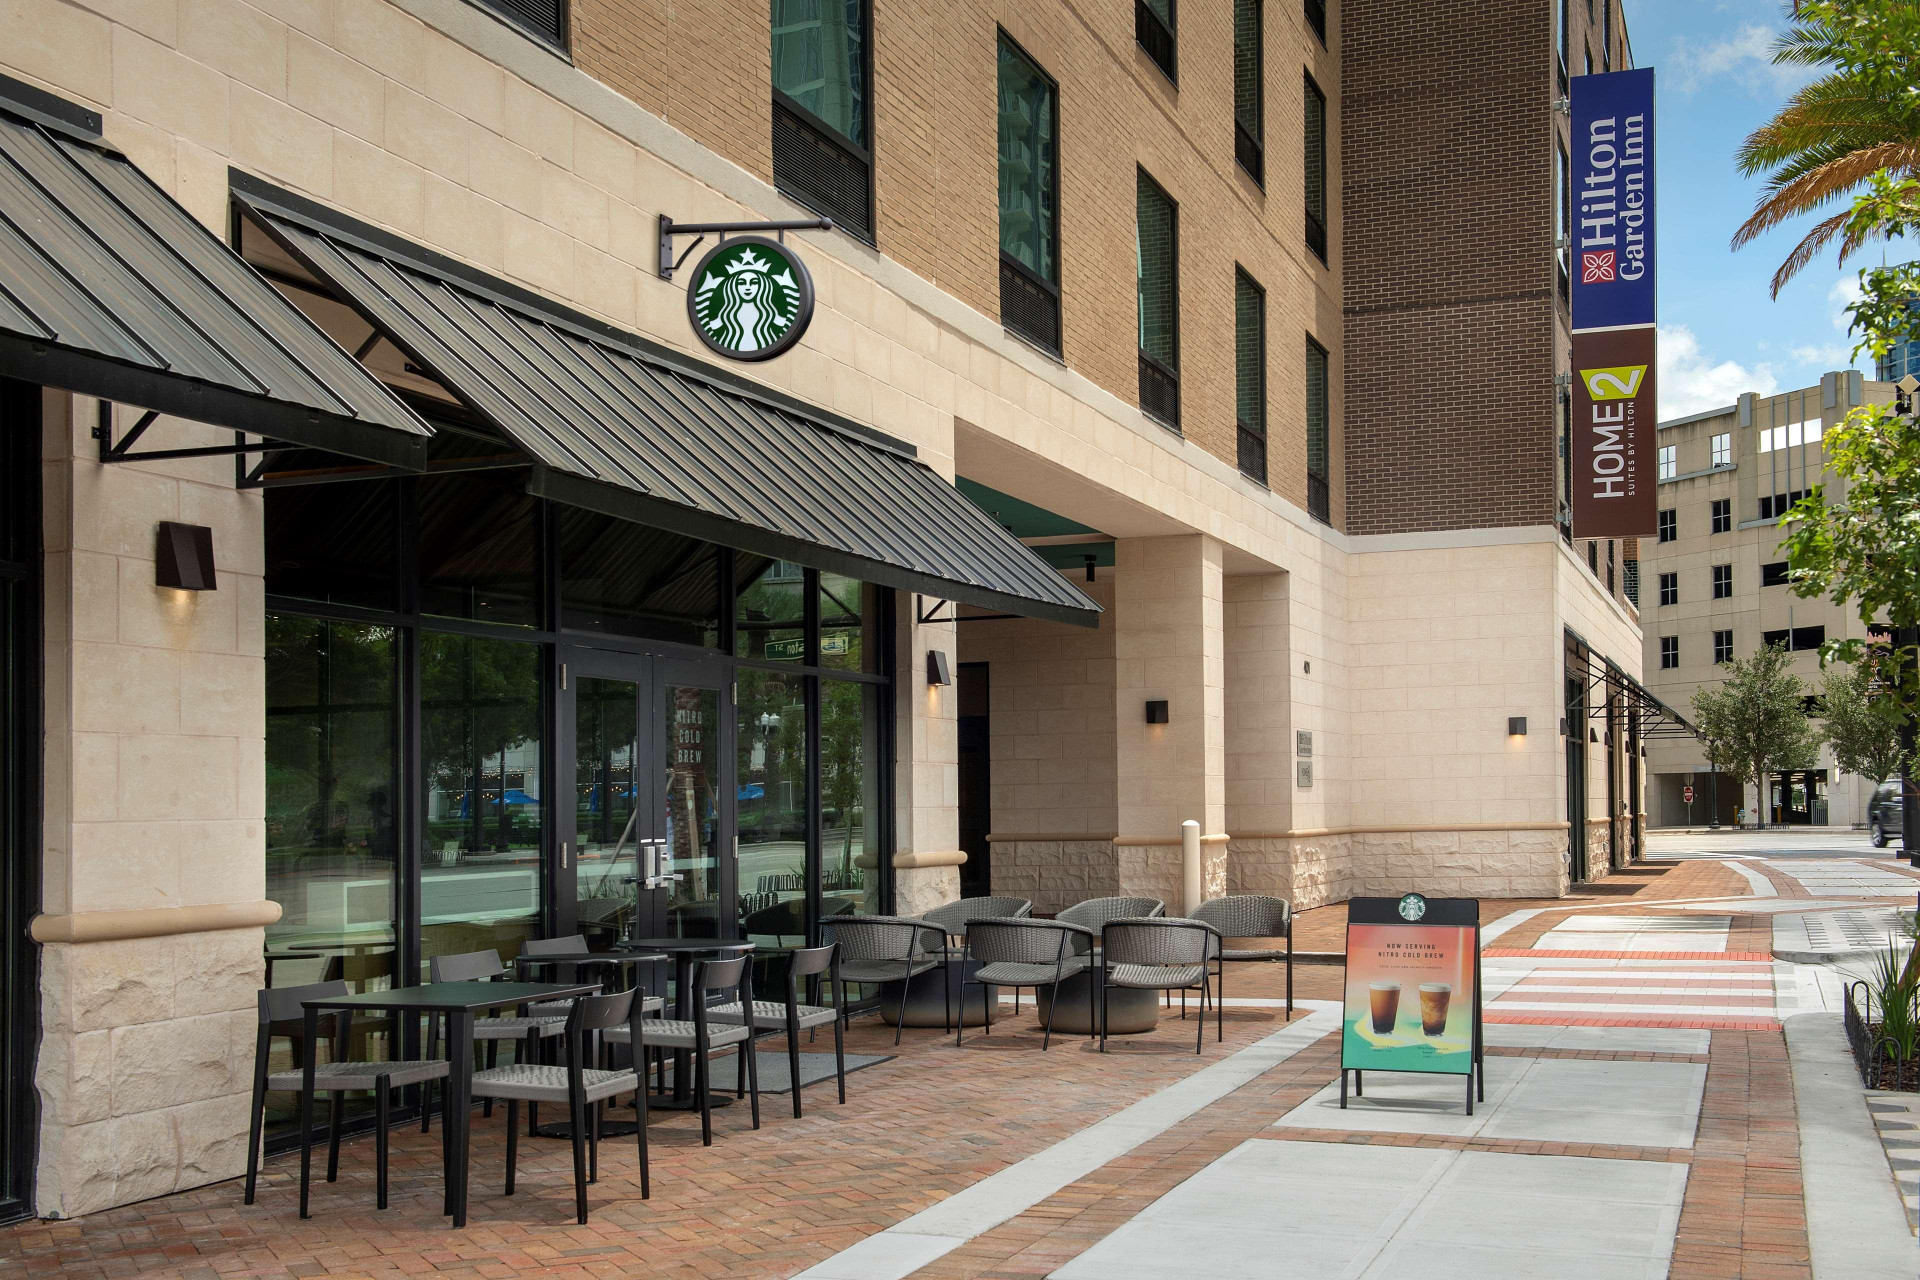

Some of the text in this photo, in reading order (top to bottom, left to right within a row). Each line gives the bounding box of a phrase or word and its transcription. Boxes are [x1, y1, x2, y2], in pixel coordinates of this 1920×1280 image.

[1581, 116, 1616, 249] Hilton
[1619, 113, 1645, 281] Garden Inn
[1627, 402, 1636, 496] SUITES BY HILTON
[676, 709, 703, 725] NITRO
[679, 729, 701, 744] COLD
[678, 749, 702, 763] BREW
